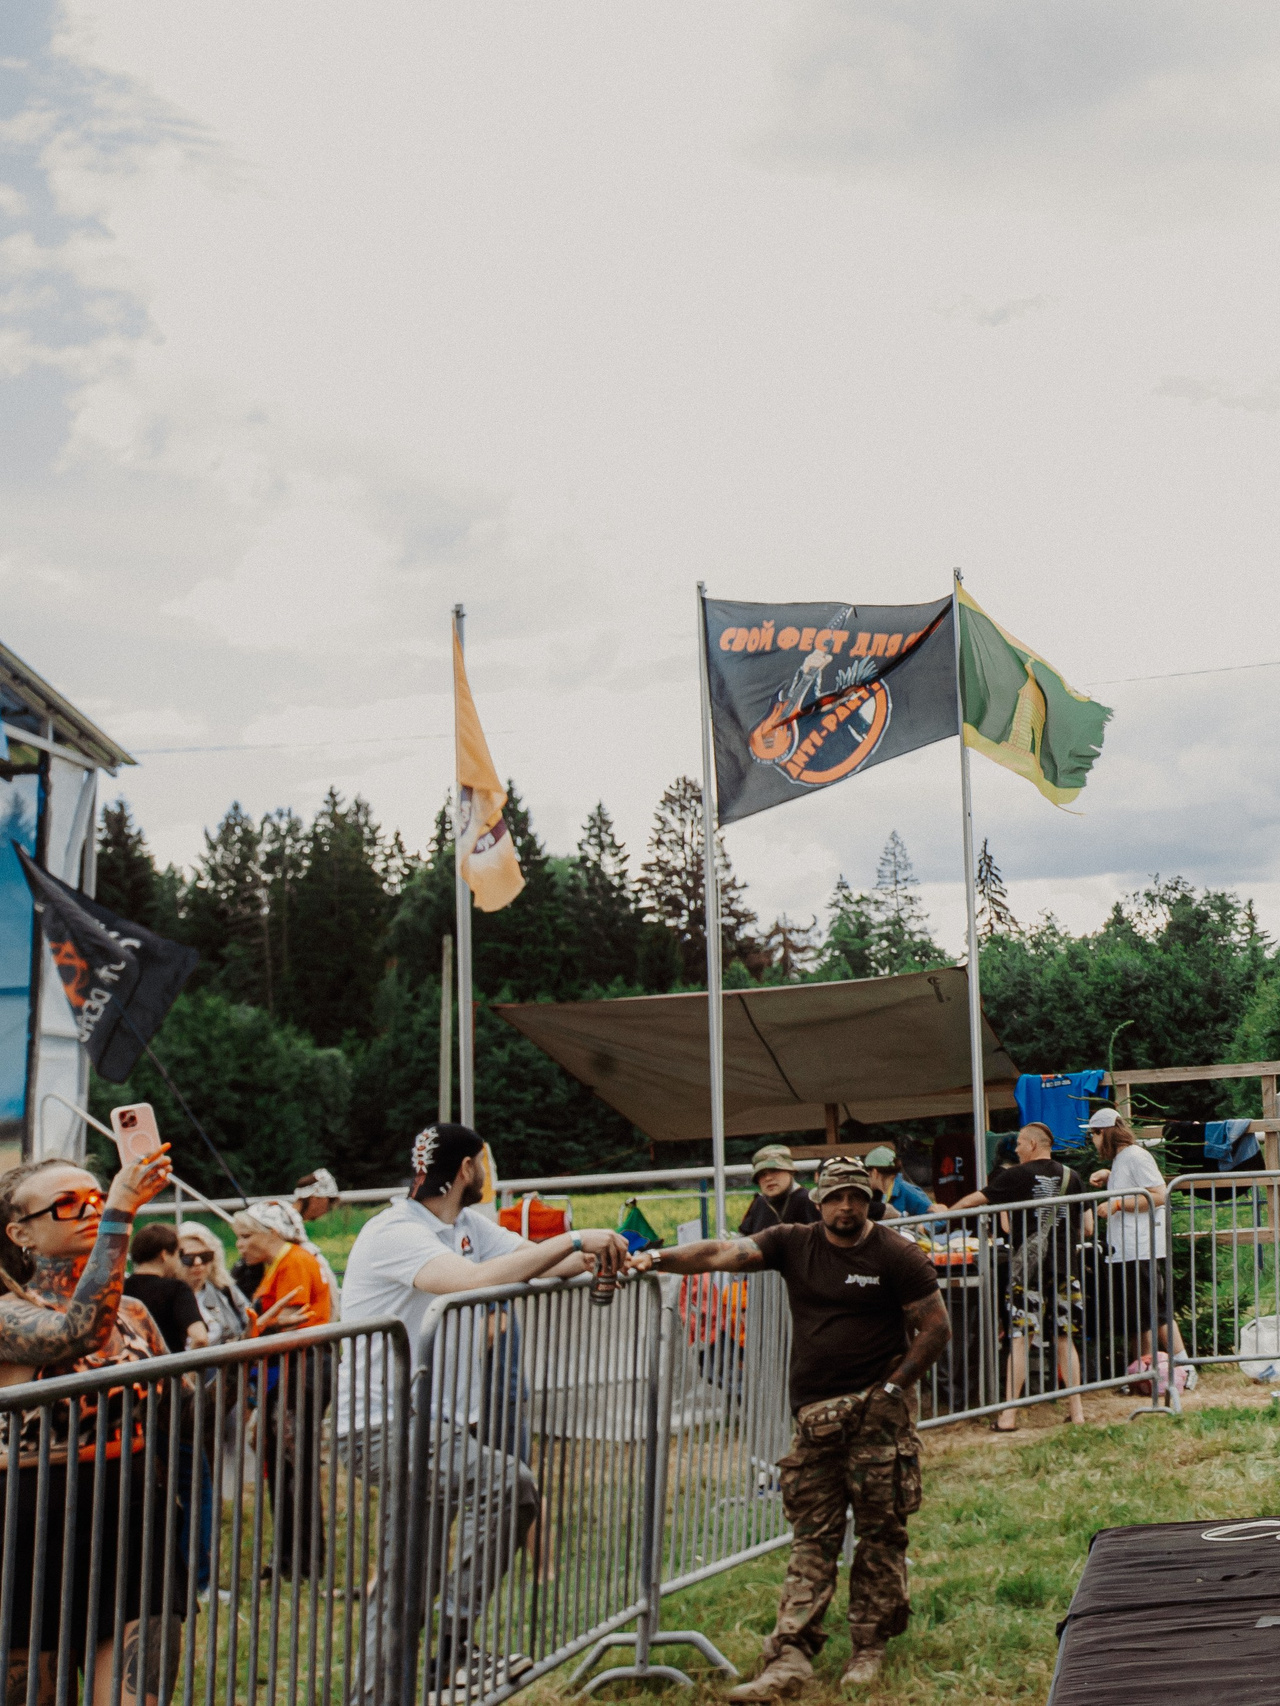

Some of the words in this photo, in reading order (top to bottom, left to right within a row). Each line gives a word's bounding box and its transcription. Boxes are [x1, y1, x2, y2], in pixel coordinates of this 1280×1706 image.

[719, 619, 775, 652] СВОЙ
[776, 626, 849, 654] ФЕСТ
[849, 632, 903, 658] ДЛЯ
